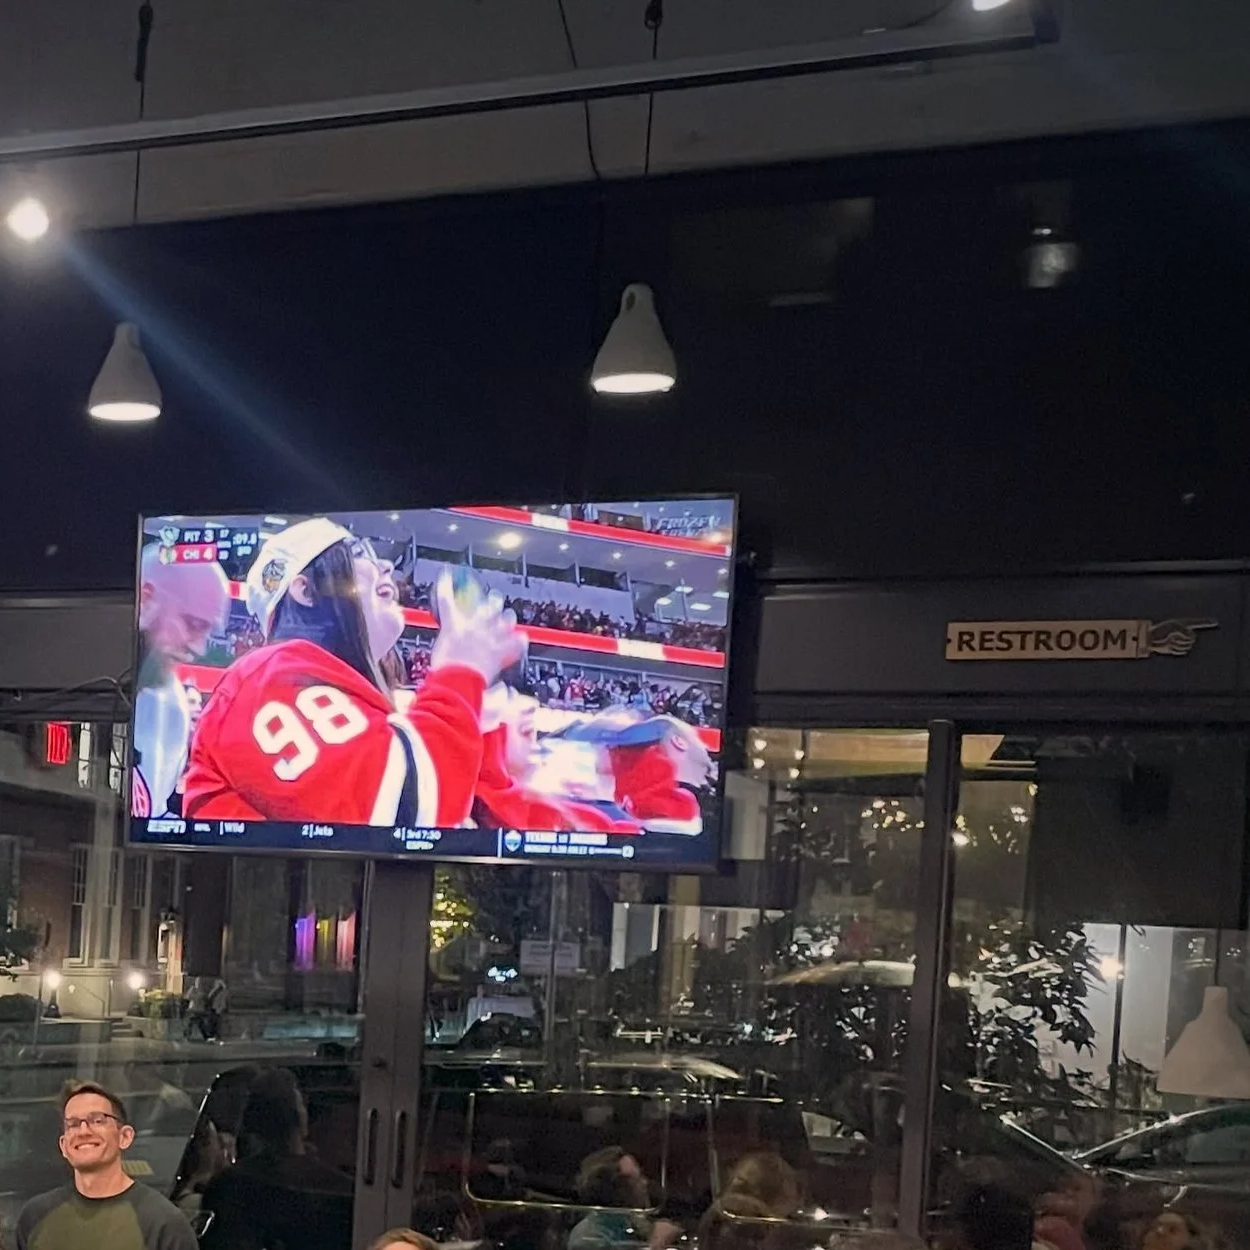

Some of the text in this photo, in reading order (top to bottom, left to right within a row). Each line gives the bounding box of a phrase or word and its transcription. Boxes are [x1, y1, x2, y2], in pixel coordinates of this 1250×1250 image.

[184, 529, 214, 543] PIT 3
[183, 548, 200, 560] CHI
[203, 547, 213, 560] 4
[957, 628, 1128, 653] RESTROOM
[253, 685, 368, 782] 98
[147, 819, 187, 834] ESPN
